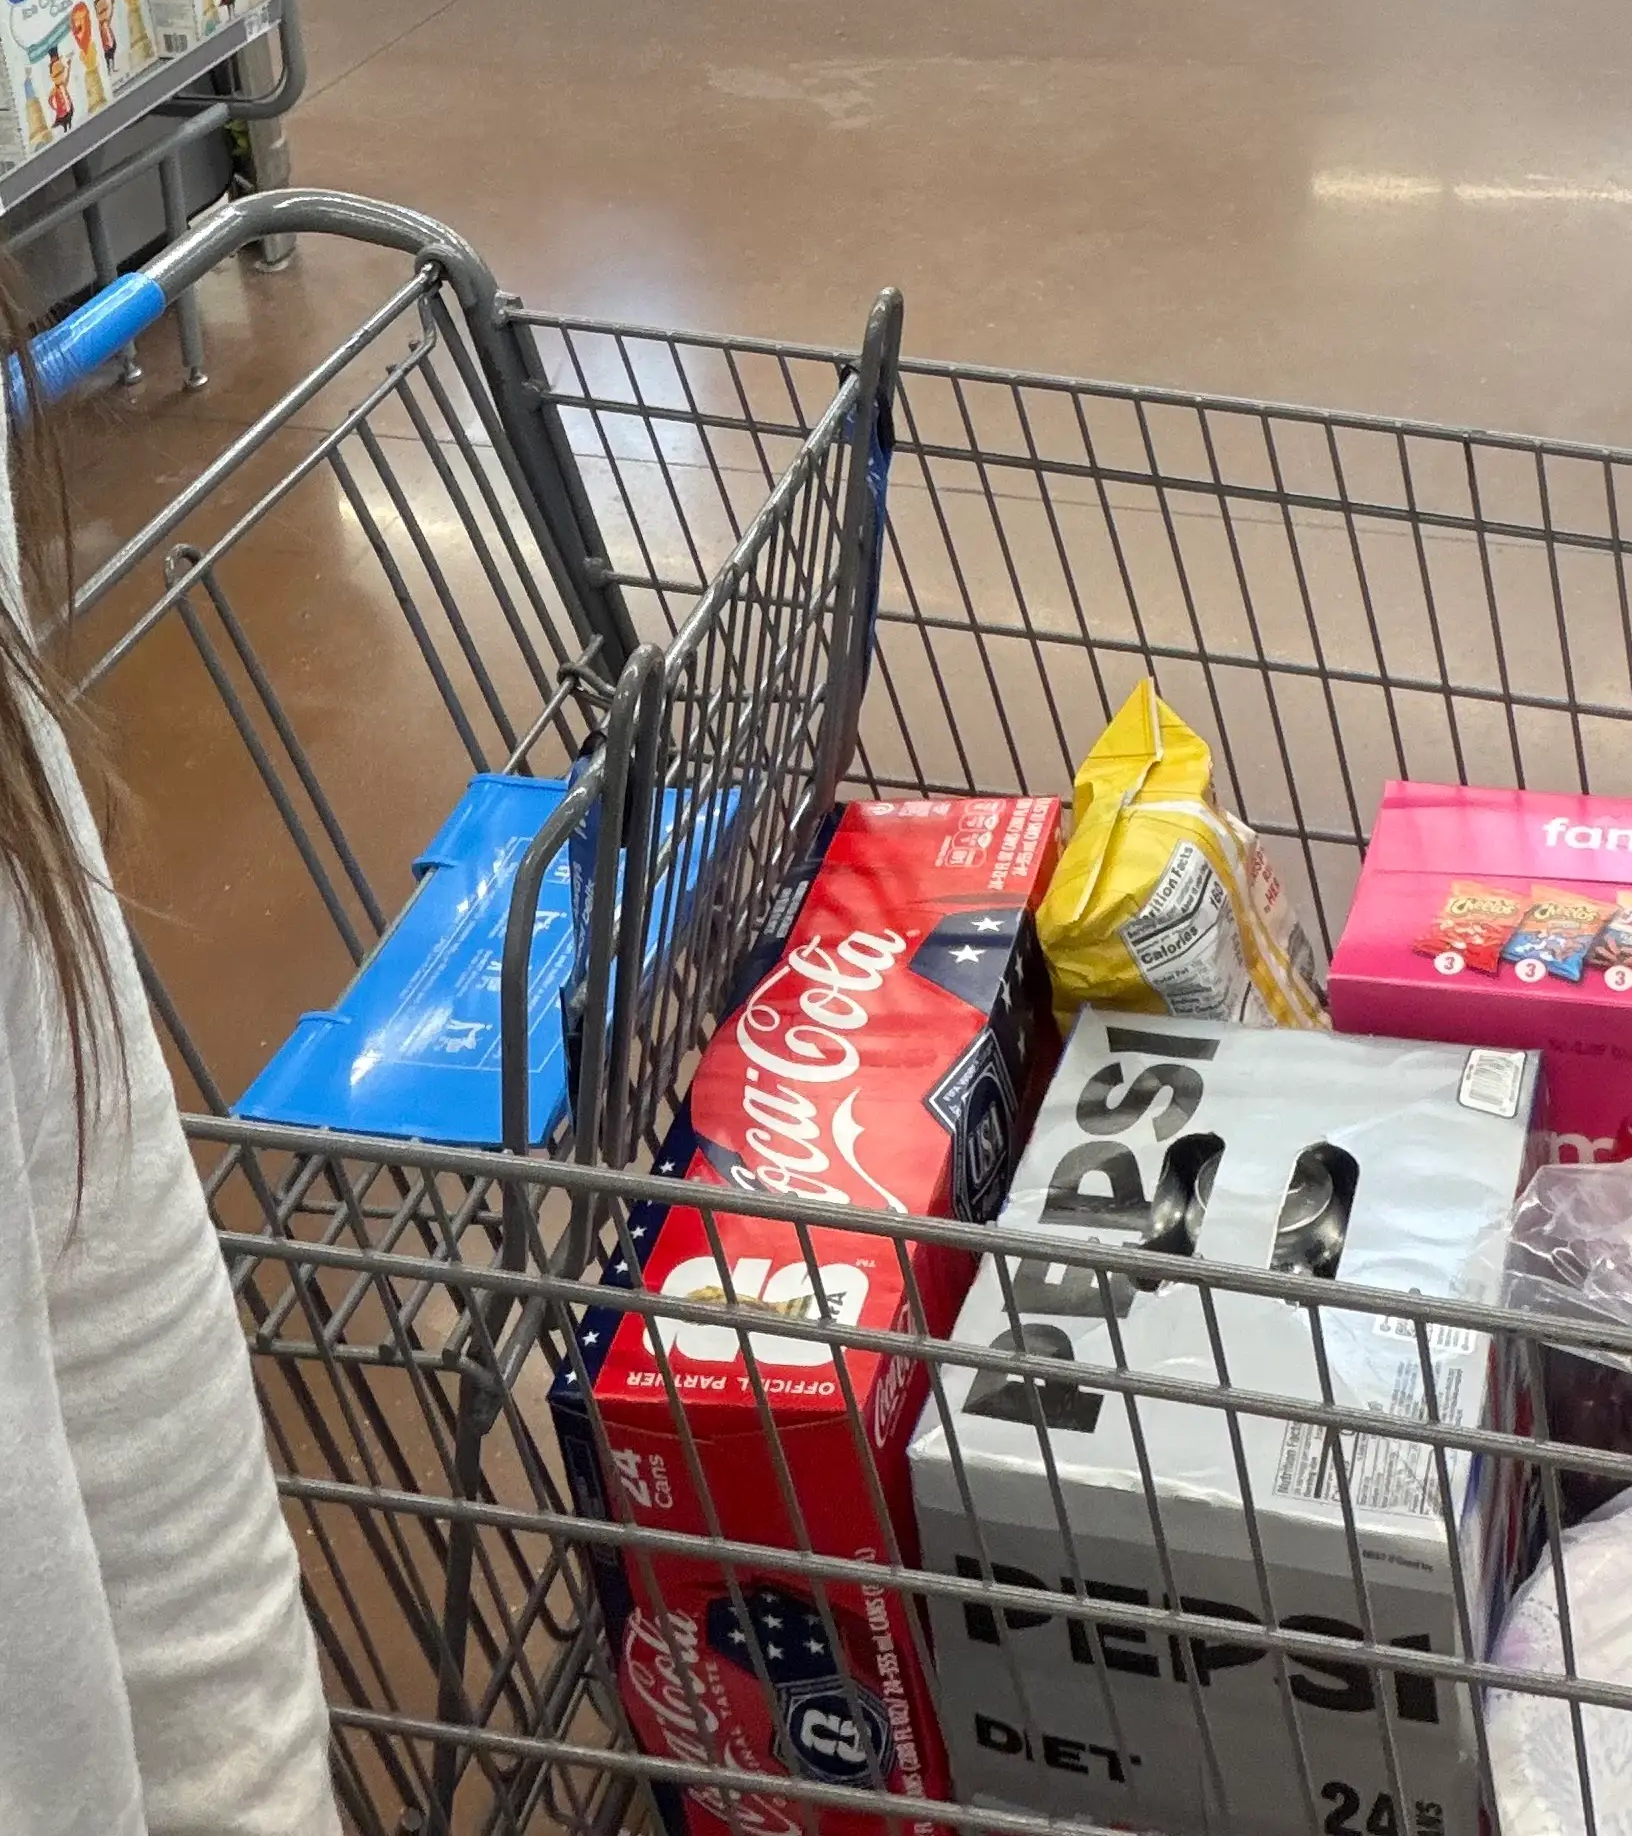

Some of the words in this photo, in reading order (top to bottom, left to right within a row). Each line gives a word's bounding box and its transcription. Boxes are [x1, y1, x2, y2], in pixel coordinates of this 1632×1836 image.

[1173, 846, 1193, 882] Facts
[1140, 925, 1199, 964] Calories
[1444, 956, 1454, 970] 3
[1526, 964, 1536, 977] 3
[1615, 971, 1626, 985] 3
[731, 926, 908, 1204] oca-Cola
[961, 1026, 1221, 1435] PEPSI
[736, 1377, 835, 1397] OFFICIL
[612, 1446, 654, 1508] 24
[653, 1454, 674, 1509] Cans
[955, 1555, 1440, 1724] PEPSI
